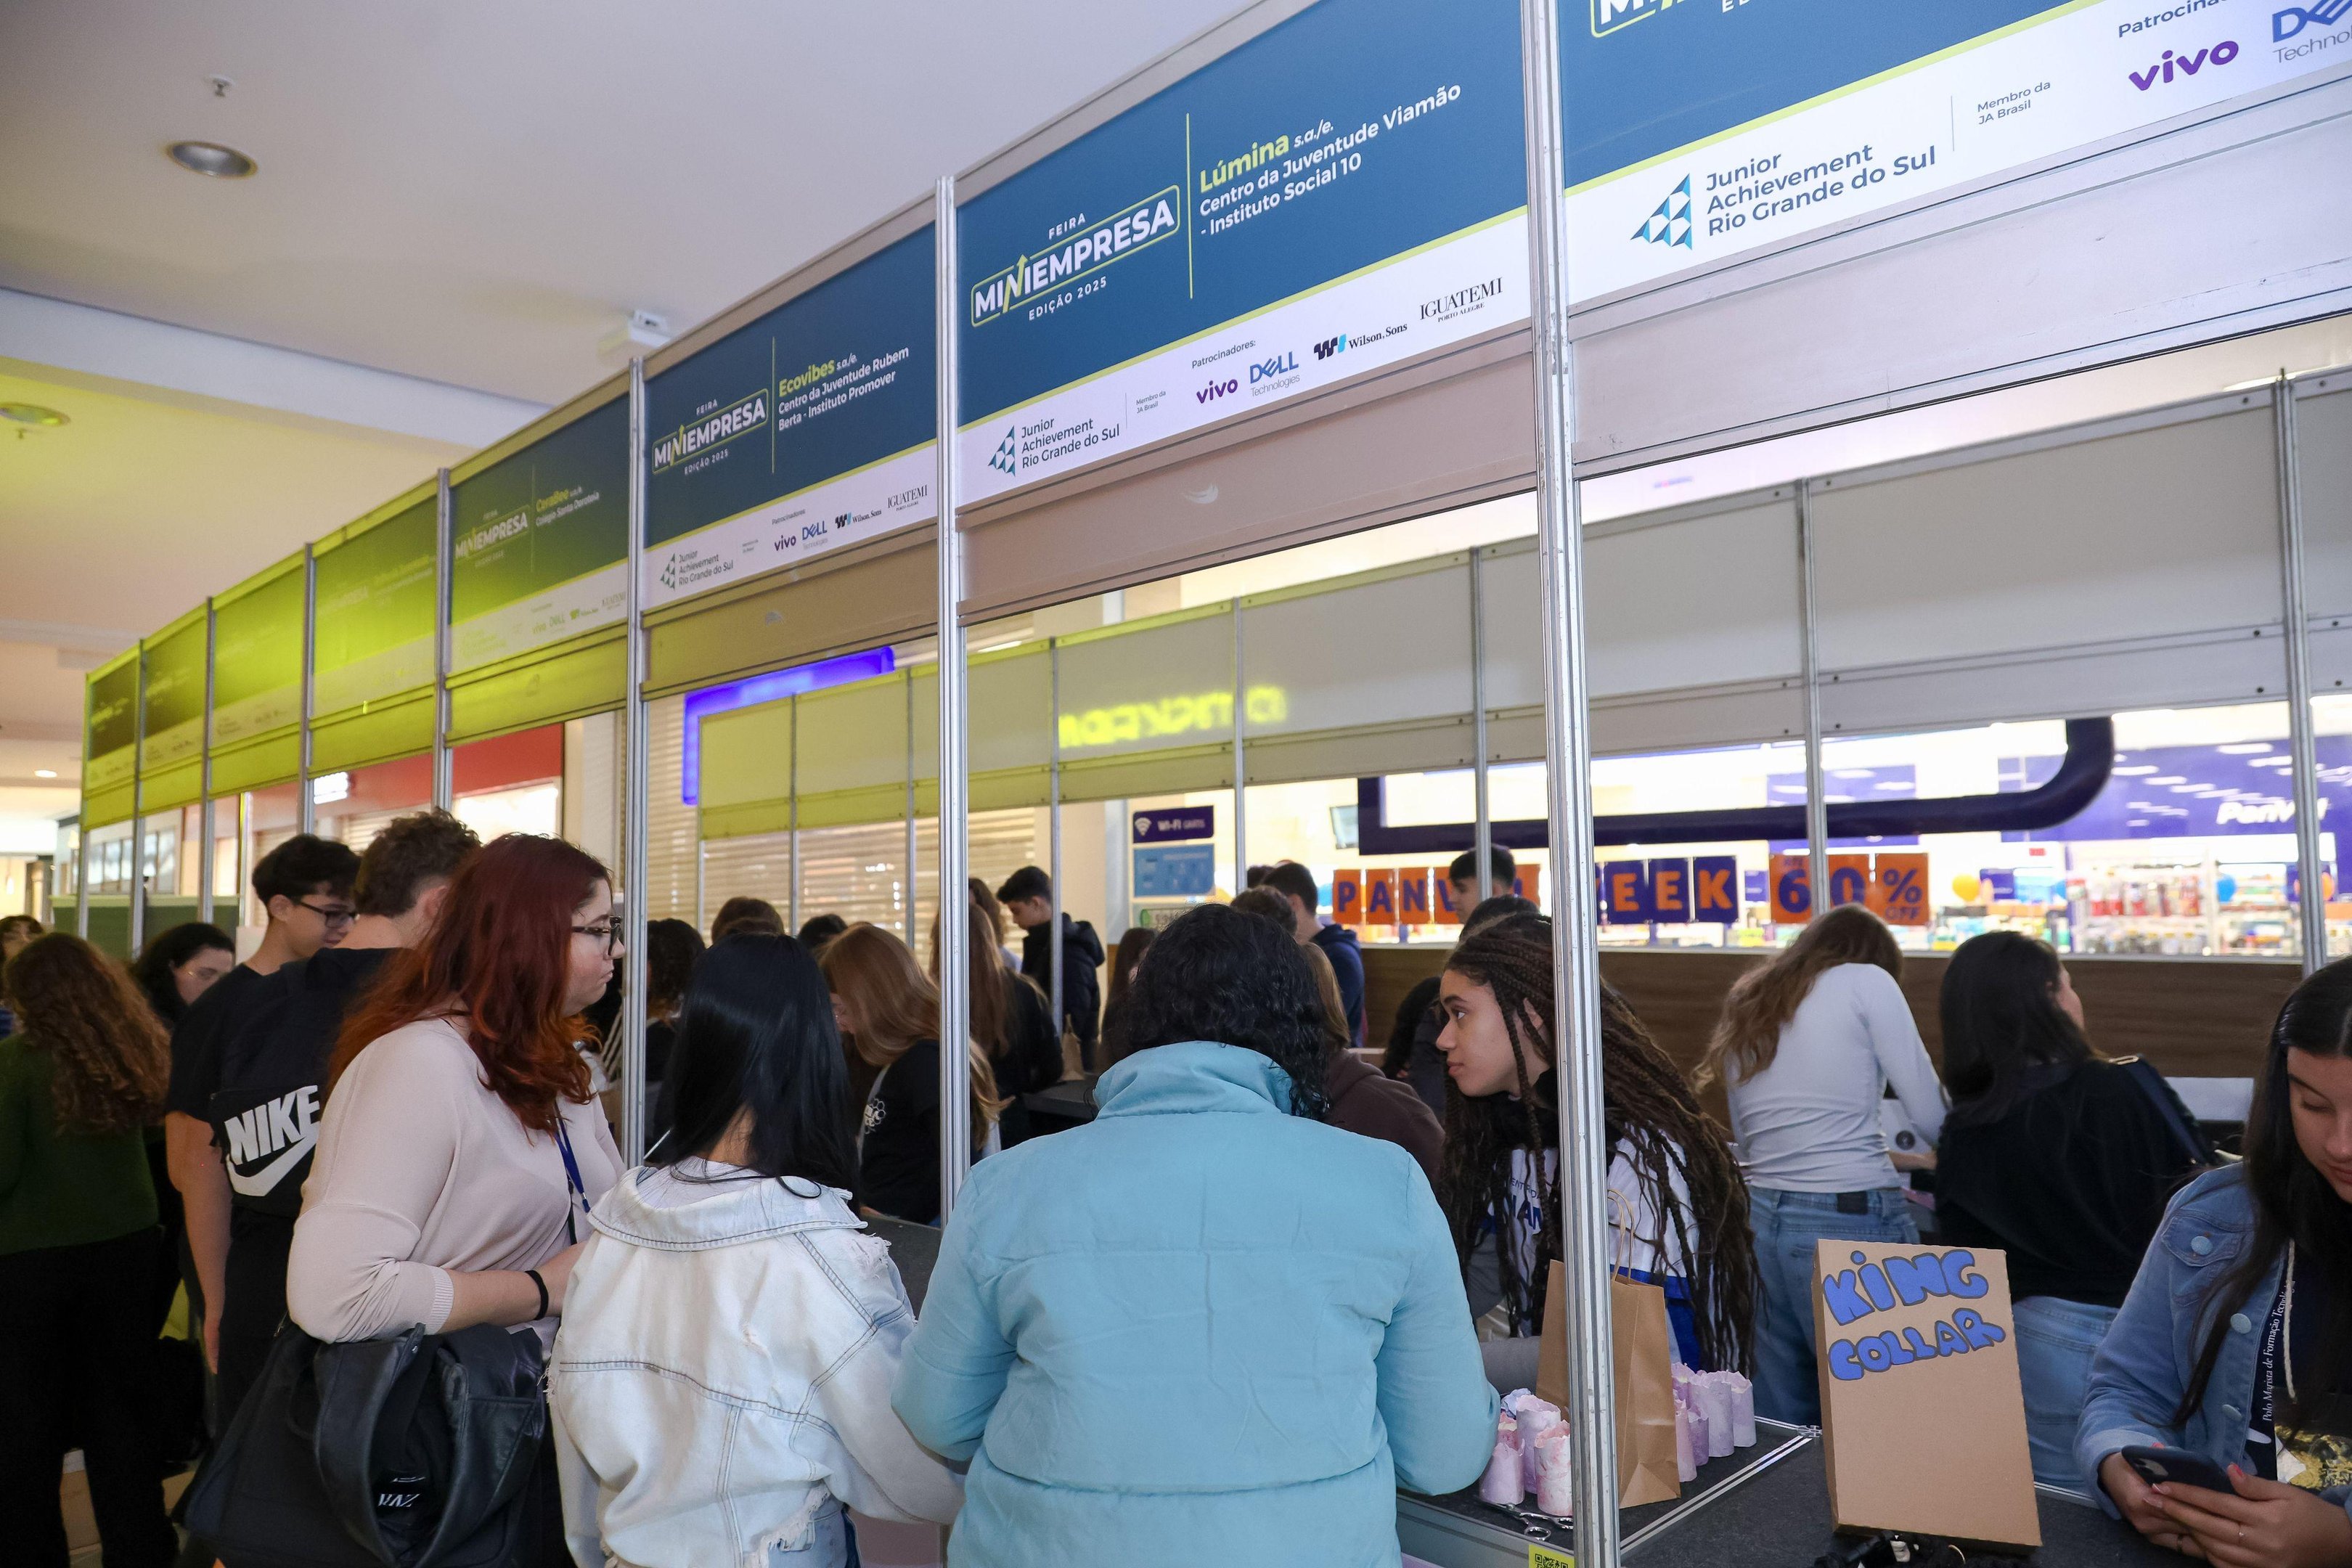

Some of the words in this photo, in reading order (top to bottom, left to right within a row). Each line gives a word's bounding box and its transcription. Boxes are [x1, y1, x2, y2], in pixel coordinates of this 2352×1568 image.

[2119, 0, 2229, 38] Patrocina
[2128, 41, 2239, 91] vivo
[1977, 89, 2031, 113] Membro
[2034, 82, 2051, 93] da
[1978, 113, 1994, 125] JA
[1998, 99, 2030, 118] Brasil
[1200, 180, 1254, 216] Centro
[1258, 168, 1279, 189] da
[1283, 122, 1379, 179] Juventude
[1383, 84, 1461, 131] Viamão
[1200, 134, 1290, 193] Lúmina
[1294, 119, 1334, 148] s.a./e.
[1706, 153, 1781, 191] Junior
[1707, 144, 1873, 215] Achievement
[1210, 192, 1281, 235] Instituto
[1284, 162, 1337, 200] Social
[1340, 152, 1362, 176] 10
[1709, 213, 1746, 236] Rio
[1752, 183, 1844, 221] Grande
[1851, 166, 1885, 189] do
[1892, 146, 1935, 176] Sul
[1049, 213, 1086, 240] FEIRA
[975, 199, 1175, 319] MINIEMPRESA
[1029, 292, 1073, 321] EDIÇÃO
[1077, 276, 1107, 298] 2025
[1419, 277, 1503, 320] IGUATEMI
[1438, 312, 1458, 322] PORTO
[1460, 303, 1485, 316] ALEGRE
[1192, 340, 1256, 369] Patrocinadores:
[1250, 351, 1299, 384] DELL
[779, 359, 835, 397] Ecovibes
[779, 393, 807, 415] Centro
[809, 387, 820, 401] da
[822, 364, 870, 396] Juventude
[873, 347, 909, 372] Rubem
[1196, 379, 1238, 404] vivo
[1251, 374, 1300, 397] Technologies
[696, 399, 718, 416] FEIRA
[779, 412, 802, 430] Berta
[809, 393, 847, 418] Instituto
[849, 371, 896, 400] Promover
[1136, 393, 1158, 406] Membro
[1144, 401, 1158, 411] Brasil
[654, 398, 766, 467] MINIEMPRESA
[1021, 417, 1055, 438] Junior
[1021, 418, 1093, 454] Achievement
[1022, 455, 1039, 469] Rio
[1042, 441, 1082, 462] Grande
[1084, 432, 1099, 446] do
[1102, 424, 1120, 441] Sul
[684, 457, 709, 475] EDIÇÃO
[888, 485, 928, 508] IGUATEMI
[774, 534, 796, 552] vivo
[802, 520, 828, 540] DELL
[679, 551, 698, 563] Junior
[679, 555, 719, 573] Achievement
[679, 576, 688, 586] Rio
[690, 568, 711, 582] Grande
[714, 565, 722, 574] do
[723, 560, 733, 571] Sul
[1596, 869, 1734, 912] EEK
[225, 1085, 322, 1166] NIKE
[1828, 1307, 2006, 1381] COLLAR
[2263, 1318, 2280, 1356] Formação
[2262, 1357, 2273, 1369] de
[2262, 1371, 2273, 1402] Marista
[2262, 1403, 2272, 1421] Polo
